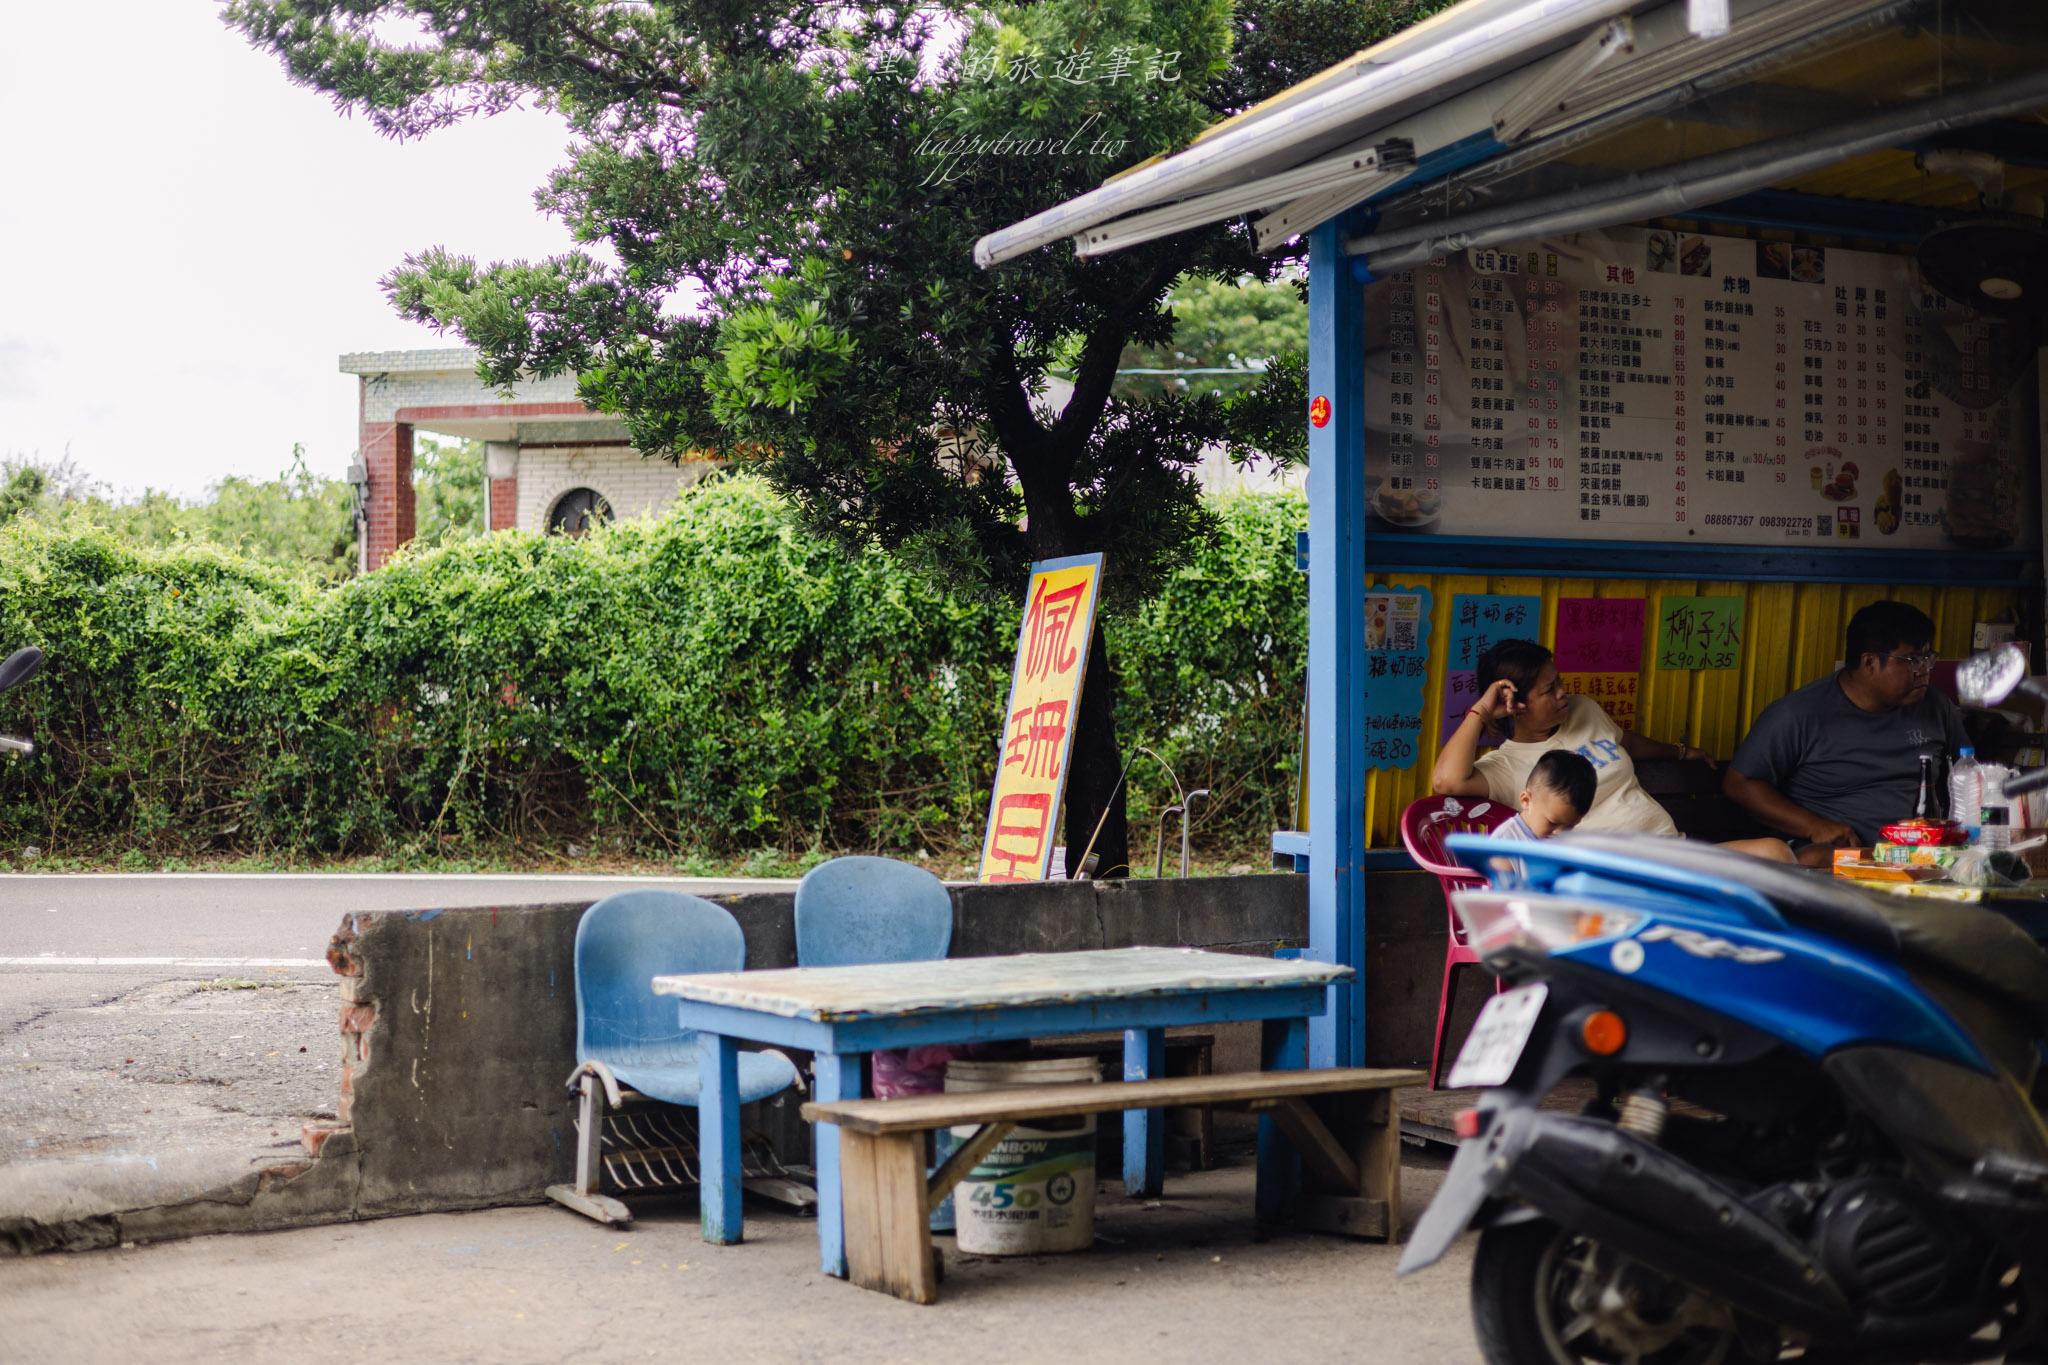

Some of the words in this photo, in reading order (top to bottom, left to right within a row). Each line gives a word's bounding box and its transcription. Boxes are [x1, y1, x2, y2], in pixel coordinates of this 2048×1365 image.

[1426, 274, 1439, 286] 30
[1606, 265, 1635, 285] 其他
[1527, 280, 1539, 292] 45
[1544, 281, 1557, 293] 50
[1723, 275, 1751, 295] 炸物
[1426, 295, 1439, 307] 45
[1527, 300, 1539, 313] 50
[1546, 301, 1558, 313] 55
[1674, 297, 1685, 309] 70
[1835, 286, 1848, 317] 吐司
[1774, 306, 1786, 318] 35
[1426, 314, 1439, 326] 40
[1527, 319, 1539, 330] 50
[1546, 321, 1558, 333] 55
[1674, 315, 1685, 326] 80
[1775, 324, 1786, 335] 35
[1804, 320, 1823, 333] 花生
[1837, 324, 1847, 334] 20
[1857, 325, 1867, 335] 30
[1876, 326, 1887, 337] 55
[1426, 334, 1439, 346] 50
[1674, 330, 1685, 341] 80
[1527, 339, 1540, 351] 50
[1546, 340, 1558, 352] 55
[1775, 343, 1787, 354] 30
[1837, 342, 1847, 352] 20
[1857, 343, 1867, 354] 30
[1876, 345, 1887, 355] 55
[1426, 354, 1439, 366] 50
[1471, 358, 1504, 371] 起司蛋
[1527, 359, 1540, 370] 45
[1546, 360, 1559, 371] 50
[1775, 362, 1786, 373] 40
[1837, 360, 1847, 370] 20
[1857, 361, 1867, 372] 30
[1876, 363, 1887, 373] 55
[1391, 372, 1414, 386] 起司
[1426, 373, 1439, 386] 45
[1527, 379, 1540, 390] 45
[1546, 380, 1559, 391] 50
[1674, 375, 1686, 386] 70
[1775, 379, 1786, 391] 40
[1837, 378, 1847, 388] 20
[1857, 379, 1867, 390] 30
[1876, 380, 1887, 391] 55
[1426, 393, 1439, 406] 45
[1674, 390, 1686, 401] 35
[1528, 398, 1540, 409] 50
[1547, 399, 1559, 410] 55
[1775, 398, 1786, 409] 40
[1837, 396, 1847, 407] 20
[1857, 397, 1867, 408] 30
[1876, 398, 1887, 409] 55
[1674, 405, 1686, 417] 45
[1426, 414, 1439, 425] 45
[1528, 418, 1540, 429] 60
[1547, 418, 1559, 430] 65
[1775, 416, 1786, 429] 45
[1837, 414, 1847, 425] 20
[1857, 415, 1867, 426] 30
[1876, 416, 1887, 427] 55
[1674, 421, 1686, 431] 40
[1426, 434, 1440, 446] 45
[1471, 437, 1504, 450] 牛肉蛋
[1528, 437, 1540, 449] 70
[1547, 438, 1559, 449] 75
[1674, 436, 1686, 446] 40
[1775, 435, 1786, 447] 50
[1837, 432, 1847, 443] 20
[1857, 433, 1867, 444] 30
[1876, 434, 1887, 445] 55
[1426, 454, 1439, 466] 60
[1674, 451, 1686, 462] 55
[1528, 457, 1540, 468] 95
[1547, 457, 1564, 469] 100
[1674, 466, 1686, 477] 45
[1775, 472, 1786, 483] 50
[1426, 478, 1439, 490] 55
[1528, 476, 1540, 488] 75
[1547, 477, 1559, 488] 80
[1674, 481, 1686, 492] 40
[1674, 496, 1686, 507] 45
[1674, 511, 1686, 522] 30
[1704, 513, 1755, 527] 088867367
[1759, 515, 1813, 529] 0983922726
[1665, 605, 1740, 650] 椰子水
[992, 1141, 1048, 1154] NBOW
[970, 1183, 1041, 1209] 450
